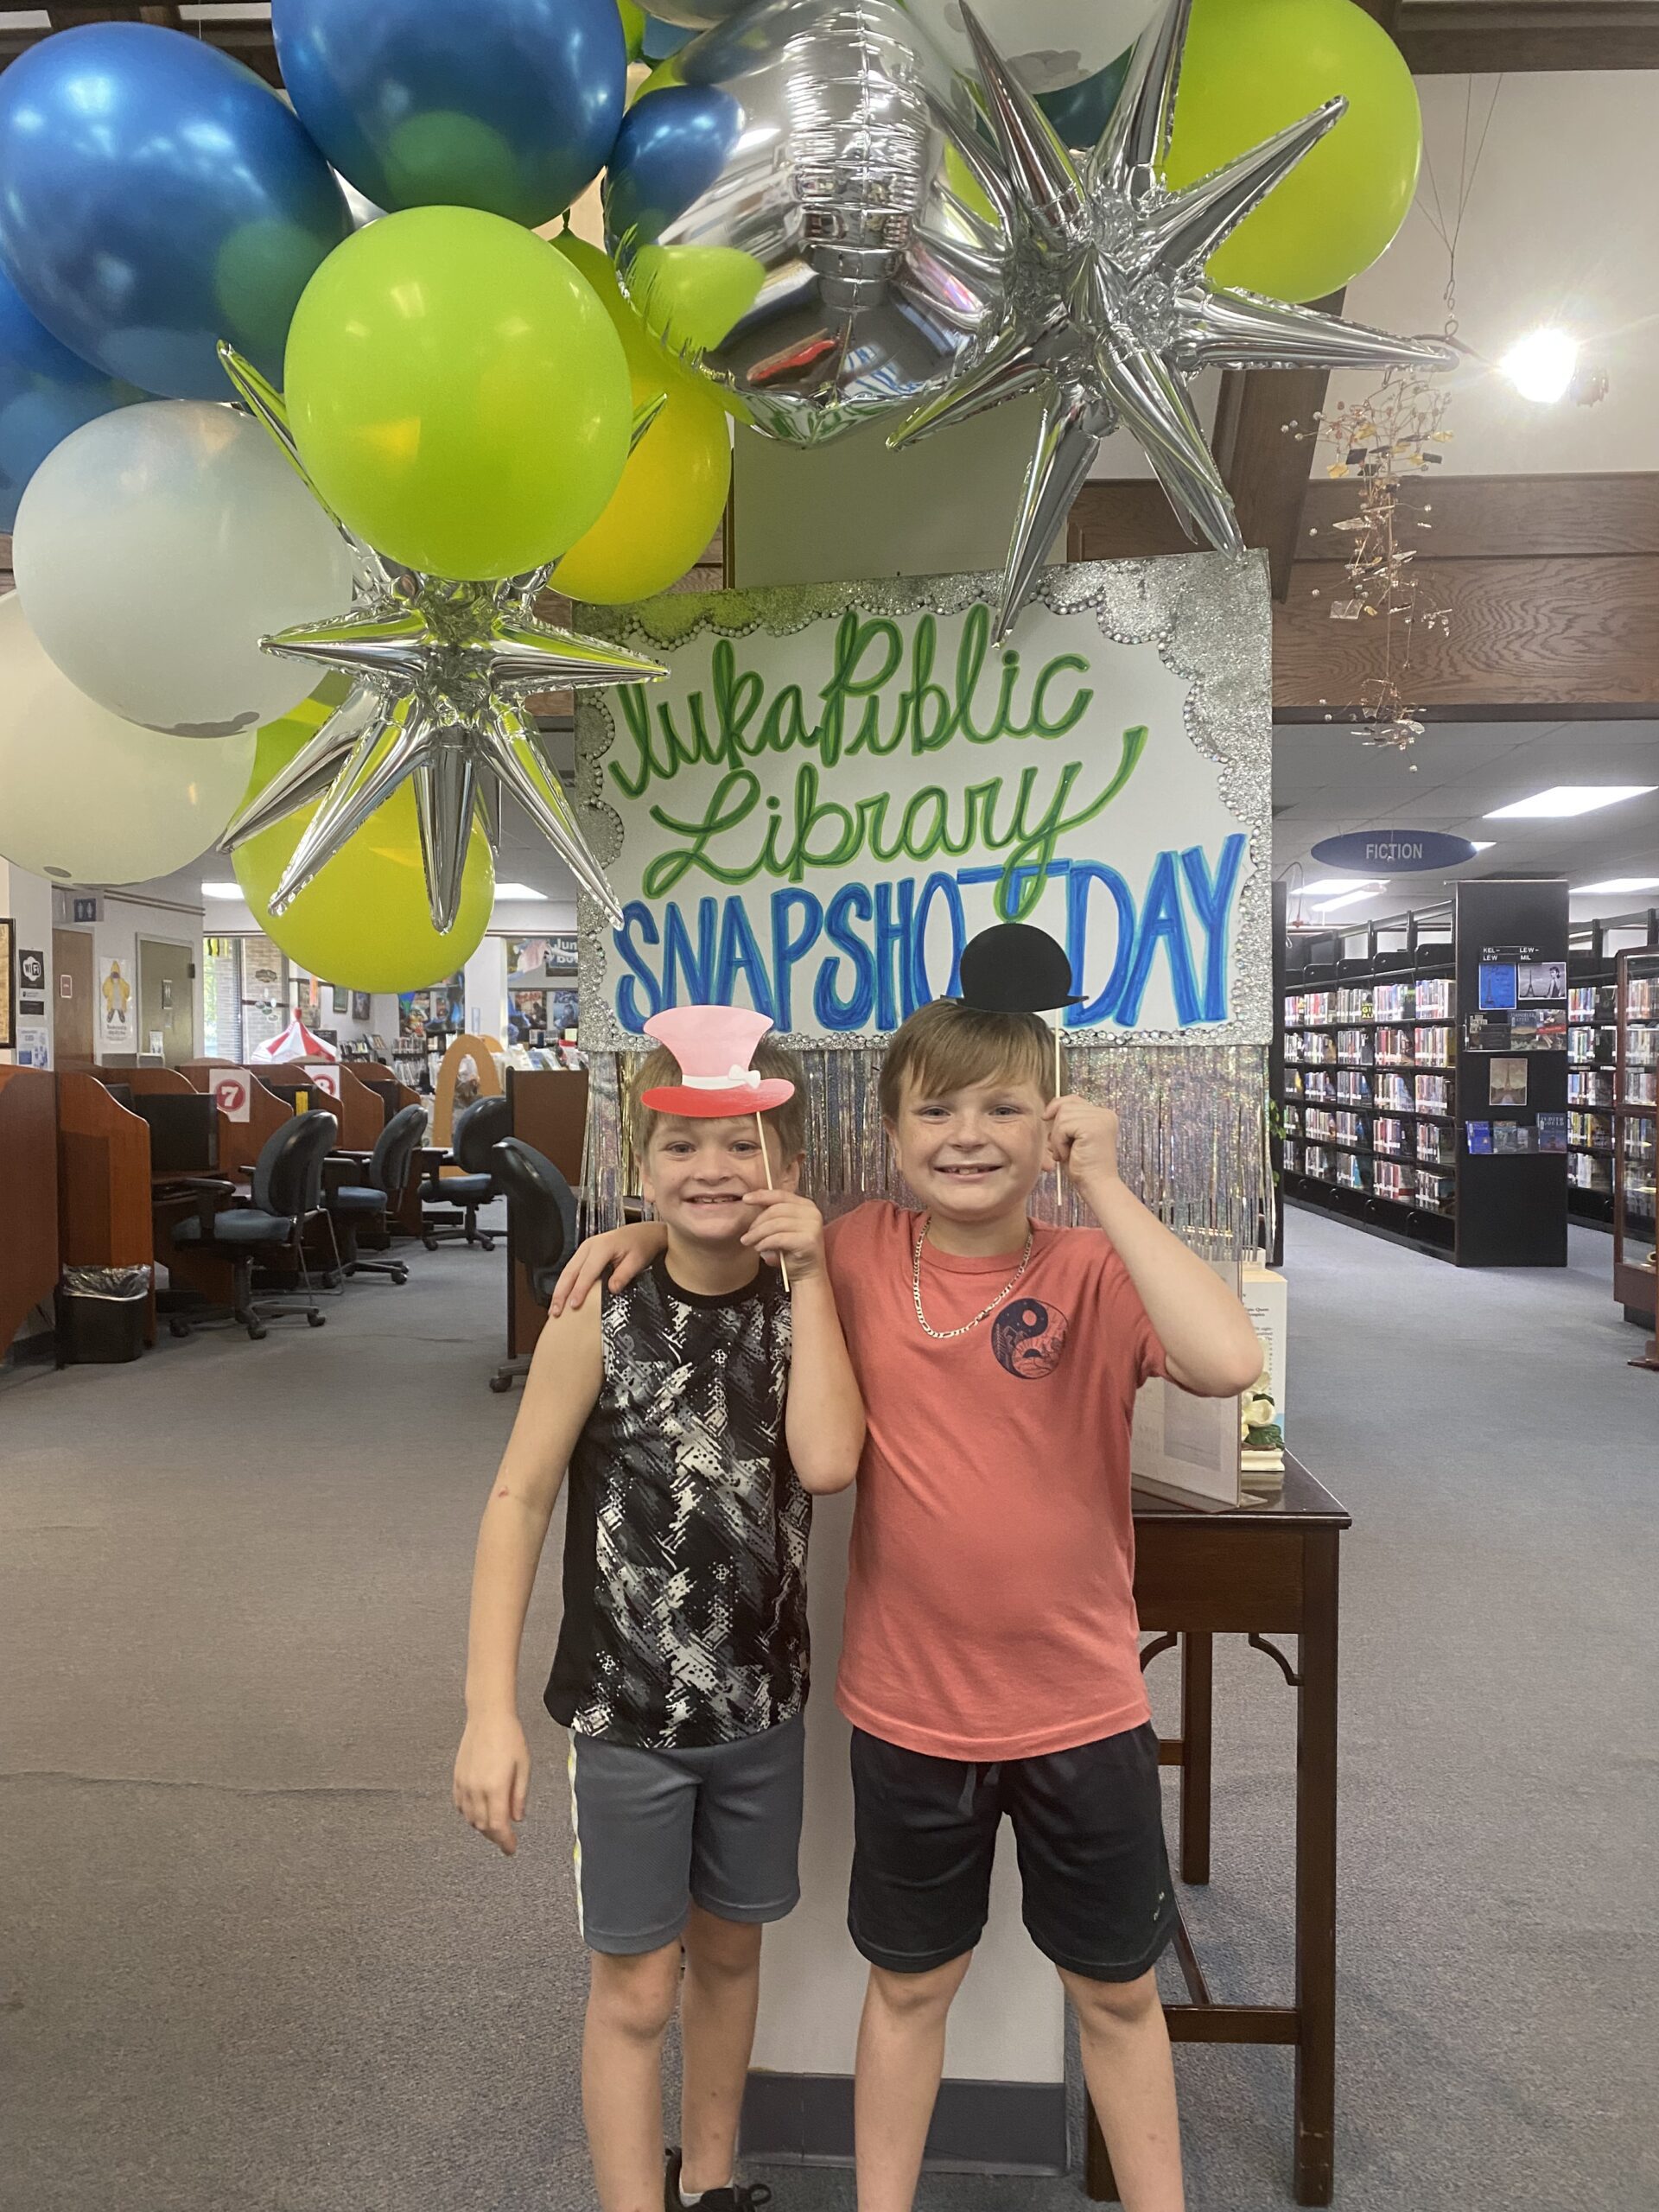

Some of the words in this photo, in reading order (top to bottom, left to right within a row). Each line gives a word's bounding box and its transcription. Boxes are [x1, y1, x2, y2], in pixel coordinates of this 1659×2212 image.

[818, 603, 1094, 769] Public
[643, 725, 1149, 924] Library
[1365, 842, 1423, 860] FICTION
[554, 938, 578, 950] Jun
[1062, 832, 1248, 1030] DAY
[220, 1086, 239, 1107] 7
